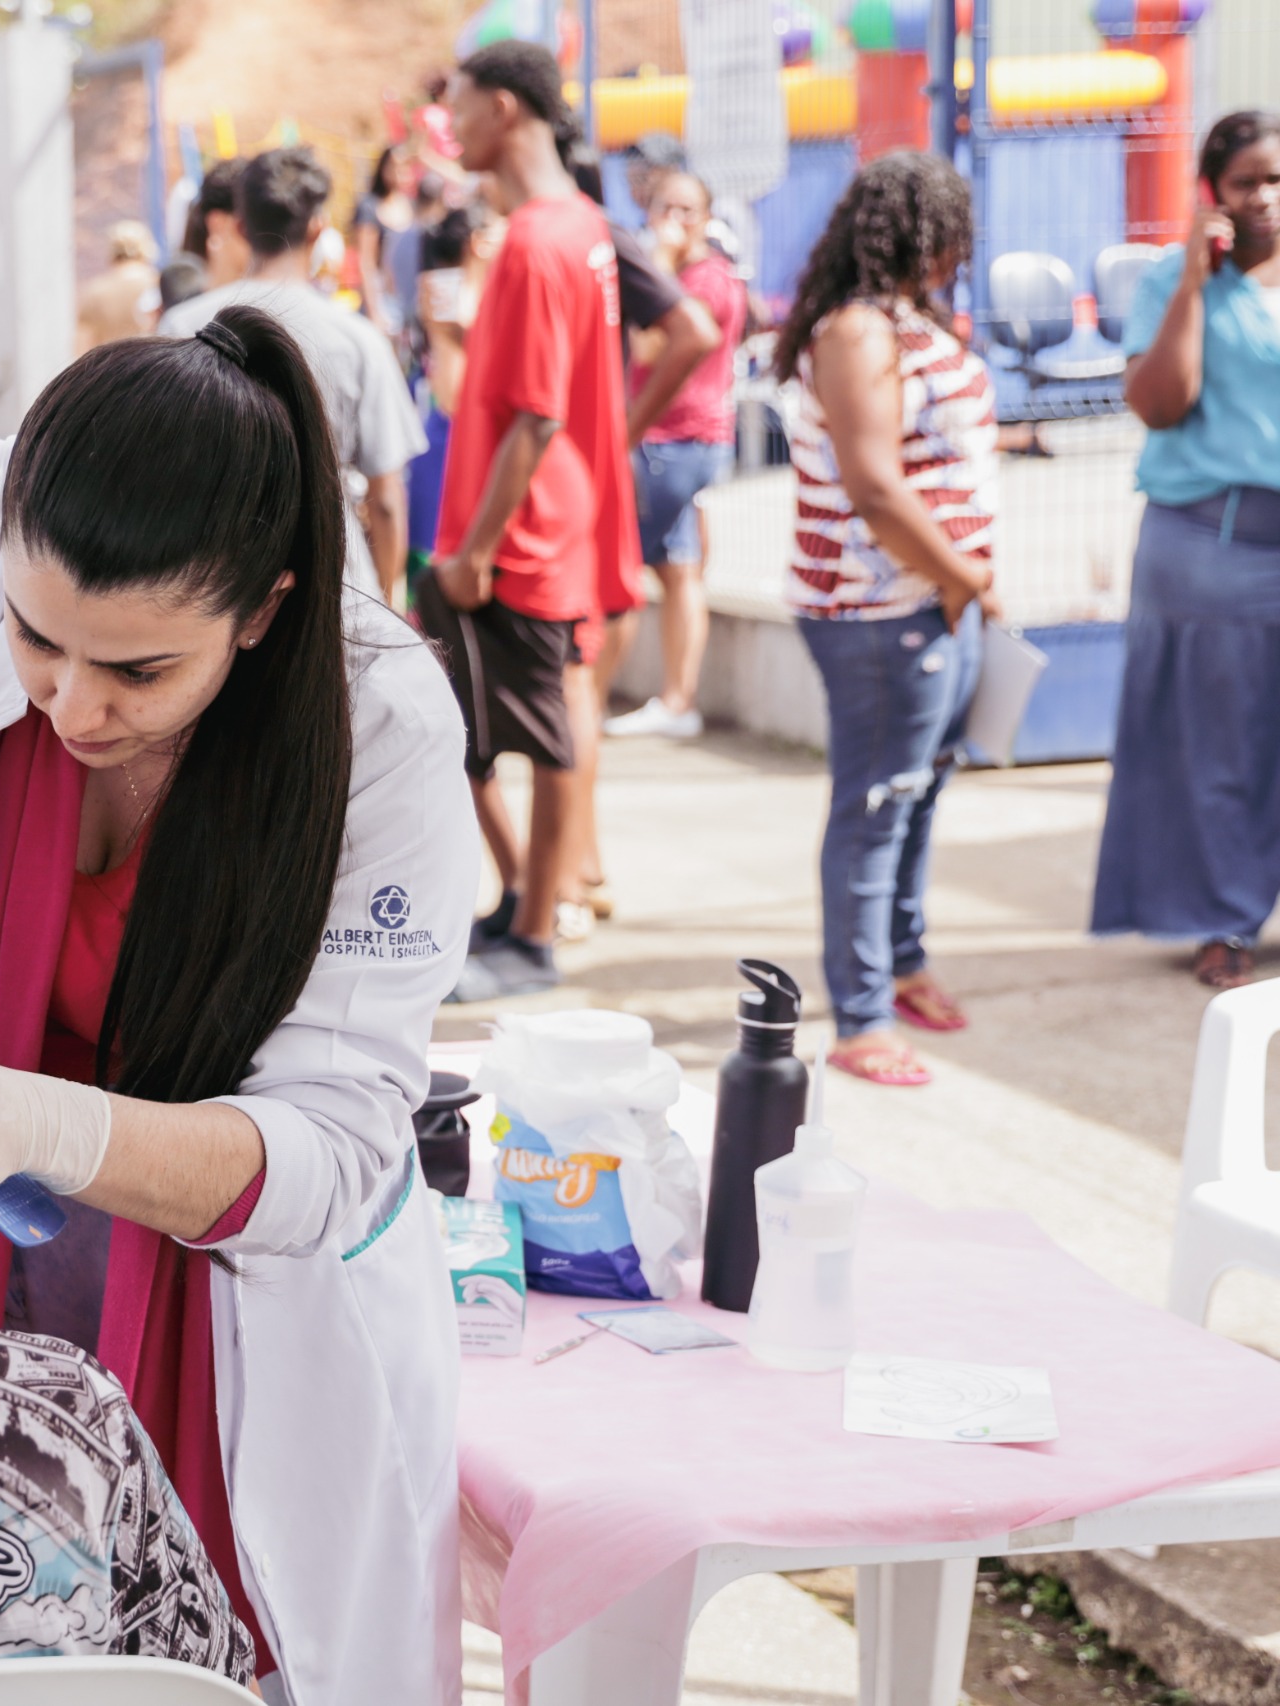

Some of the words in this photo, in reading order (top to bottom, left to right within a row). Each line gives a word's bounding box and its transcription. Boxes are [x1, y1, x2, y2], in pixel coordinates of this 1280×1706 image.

[322, 929, 384, 944] ALBERT
[389, 930, 432, 945] EINSTEIN
[324, 944, 384, 957] OSPITAL
[392, 942, 442, 958] ISRAELITA
